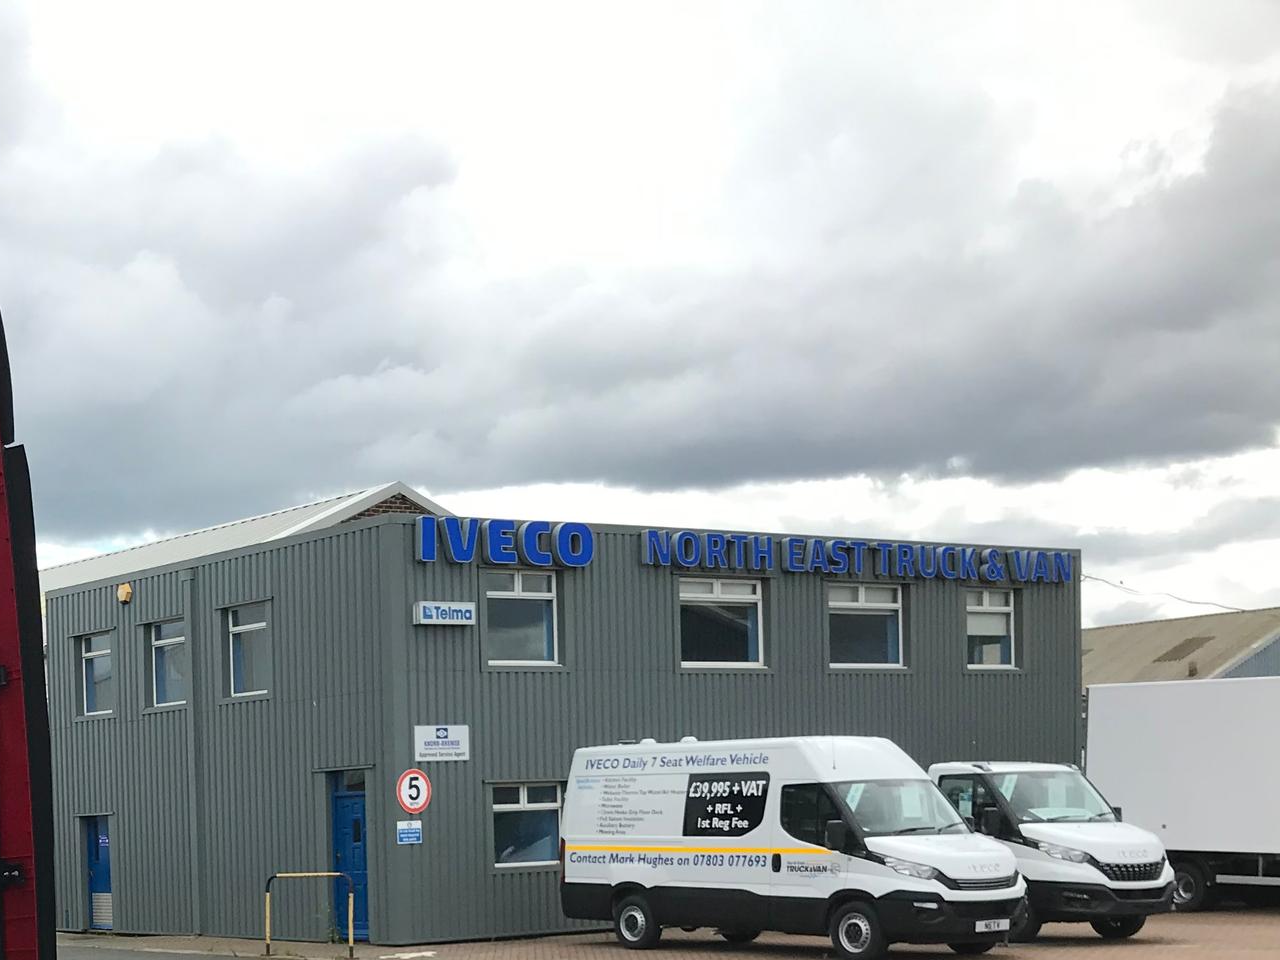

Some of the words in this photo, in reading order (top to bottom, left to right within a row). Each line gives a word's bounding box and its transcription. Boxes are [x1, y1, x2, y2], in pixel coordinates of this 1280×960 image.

[419, 515, 595, 568] IVECO
[644, 530, 773, 571] NORTH
[784, 537, 867, 573] EAST
[872, 542, 977, 581] TRUCK
[980, 548, 1005, 582] &
[1012, 550, 1071, 583] VAN
[435, 606, 473, 621] Telma
[586, 758, 619, 770] IVECO
[623, 757, 647, 771] Daily
[651, 756, 657, 767] 7
[660, 756, 682, 767] Seat
[685, 754, 727, 766] Welfare
[730, 753, 769, 765] Vehicle
[408, 776, 421, 801] 5
[689, 781, 731, 800] £39,995
[732, 782, 740, 794] +
[741, 780, 766, 796] VAT
[706, 804, 713, 813] +
[715, 803, 734, 814] RFL
[736, 804, 743, 813] +
[697, 817, 710, 828] 1st
[712, 817, 730, 831] Reg
[732, 817, 749, 828] Fee
[569, 852, 606, 864] Contact
[608, 853, 635, 864] Mark
[638, 853, 674, 868] Hughes
[677, 856, 689, 866] on
[693, 854, 724, 866] 07803
[728, 855, 767, 867] 077693
